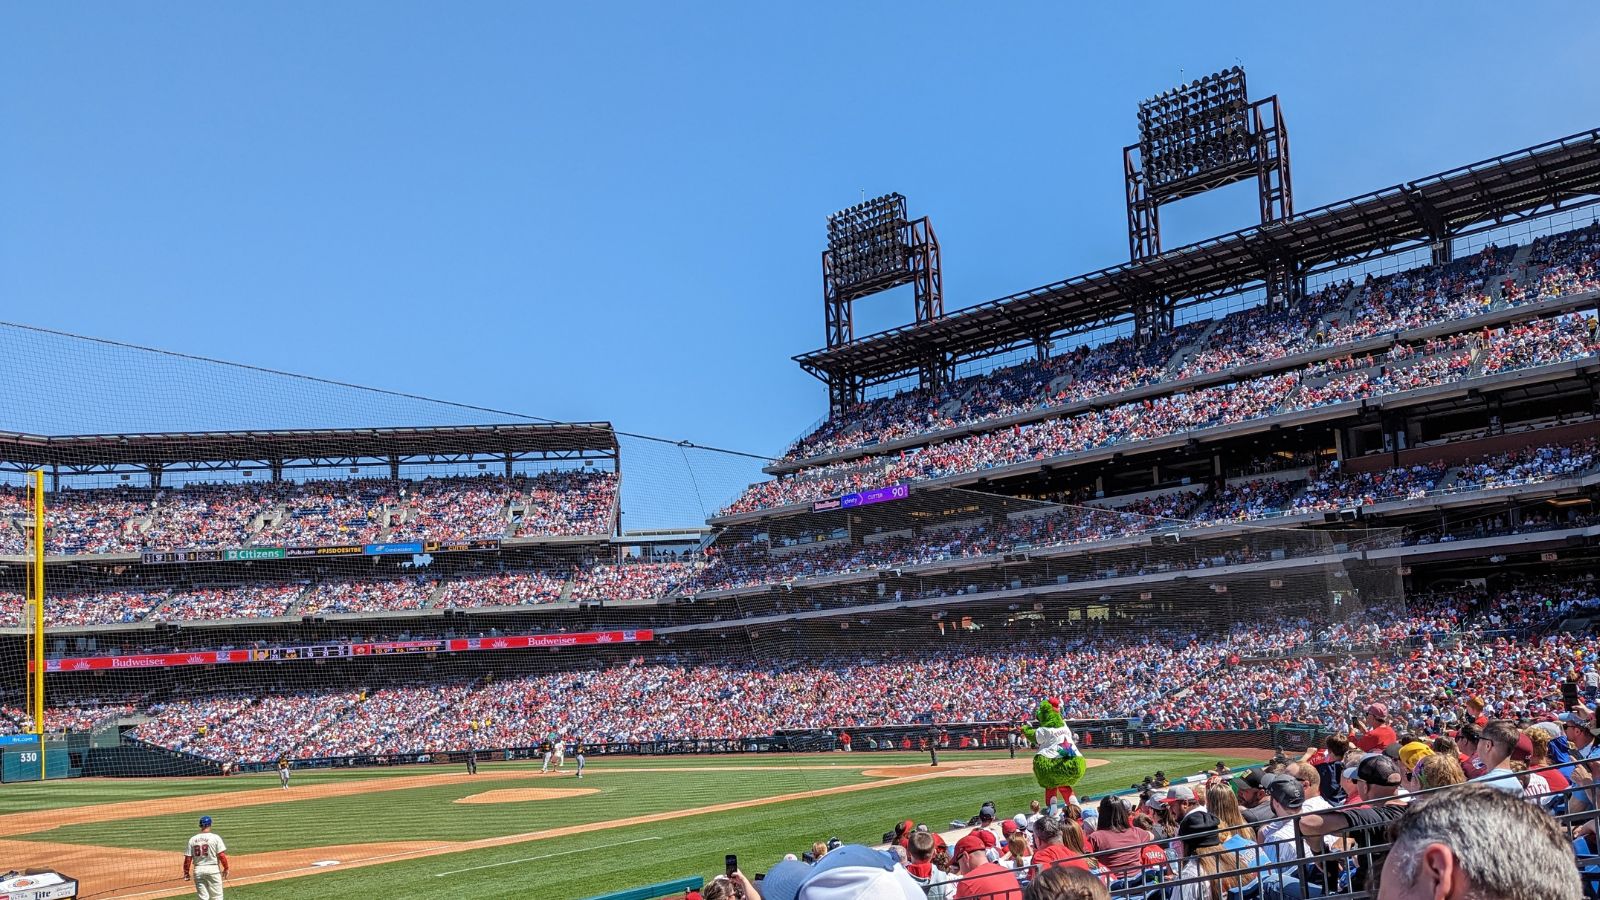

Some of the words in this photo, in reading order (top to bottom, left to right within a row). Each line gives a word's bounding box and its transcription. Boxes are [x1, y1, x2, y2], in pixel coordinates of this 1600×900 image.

[892, 487, 904, 497] 90
[239, 550, 280, 559] Citizens
[528, 637, 576, 646] Budweiser
[112, 658, 165, 667] Budweiser
[20, 752, 37, 763] 330
[35, 891, 51, 900] Lite
